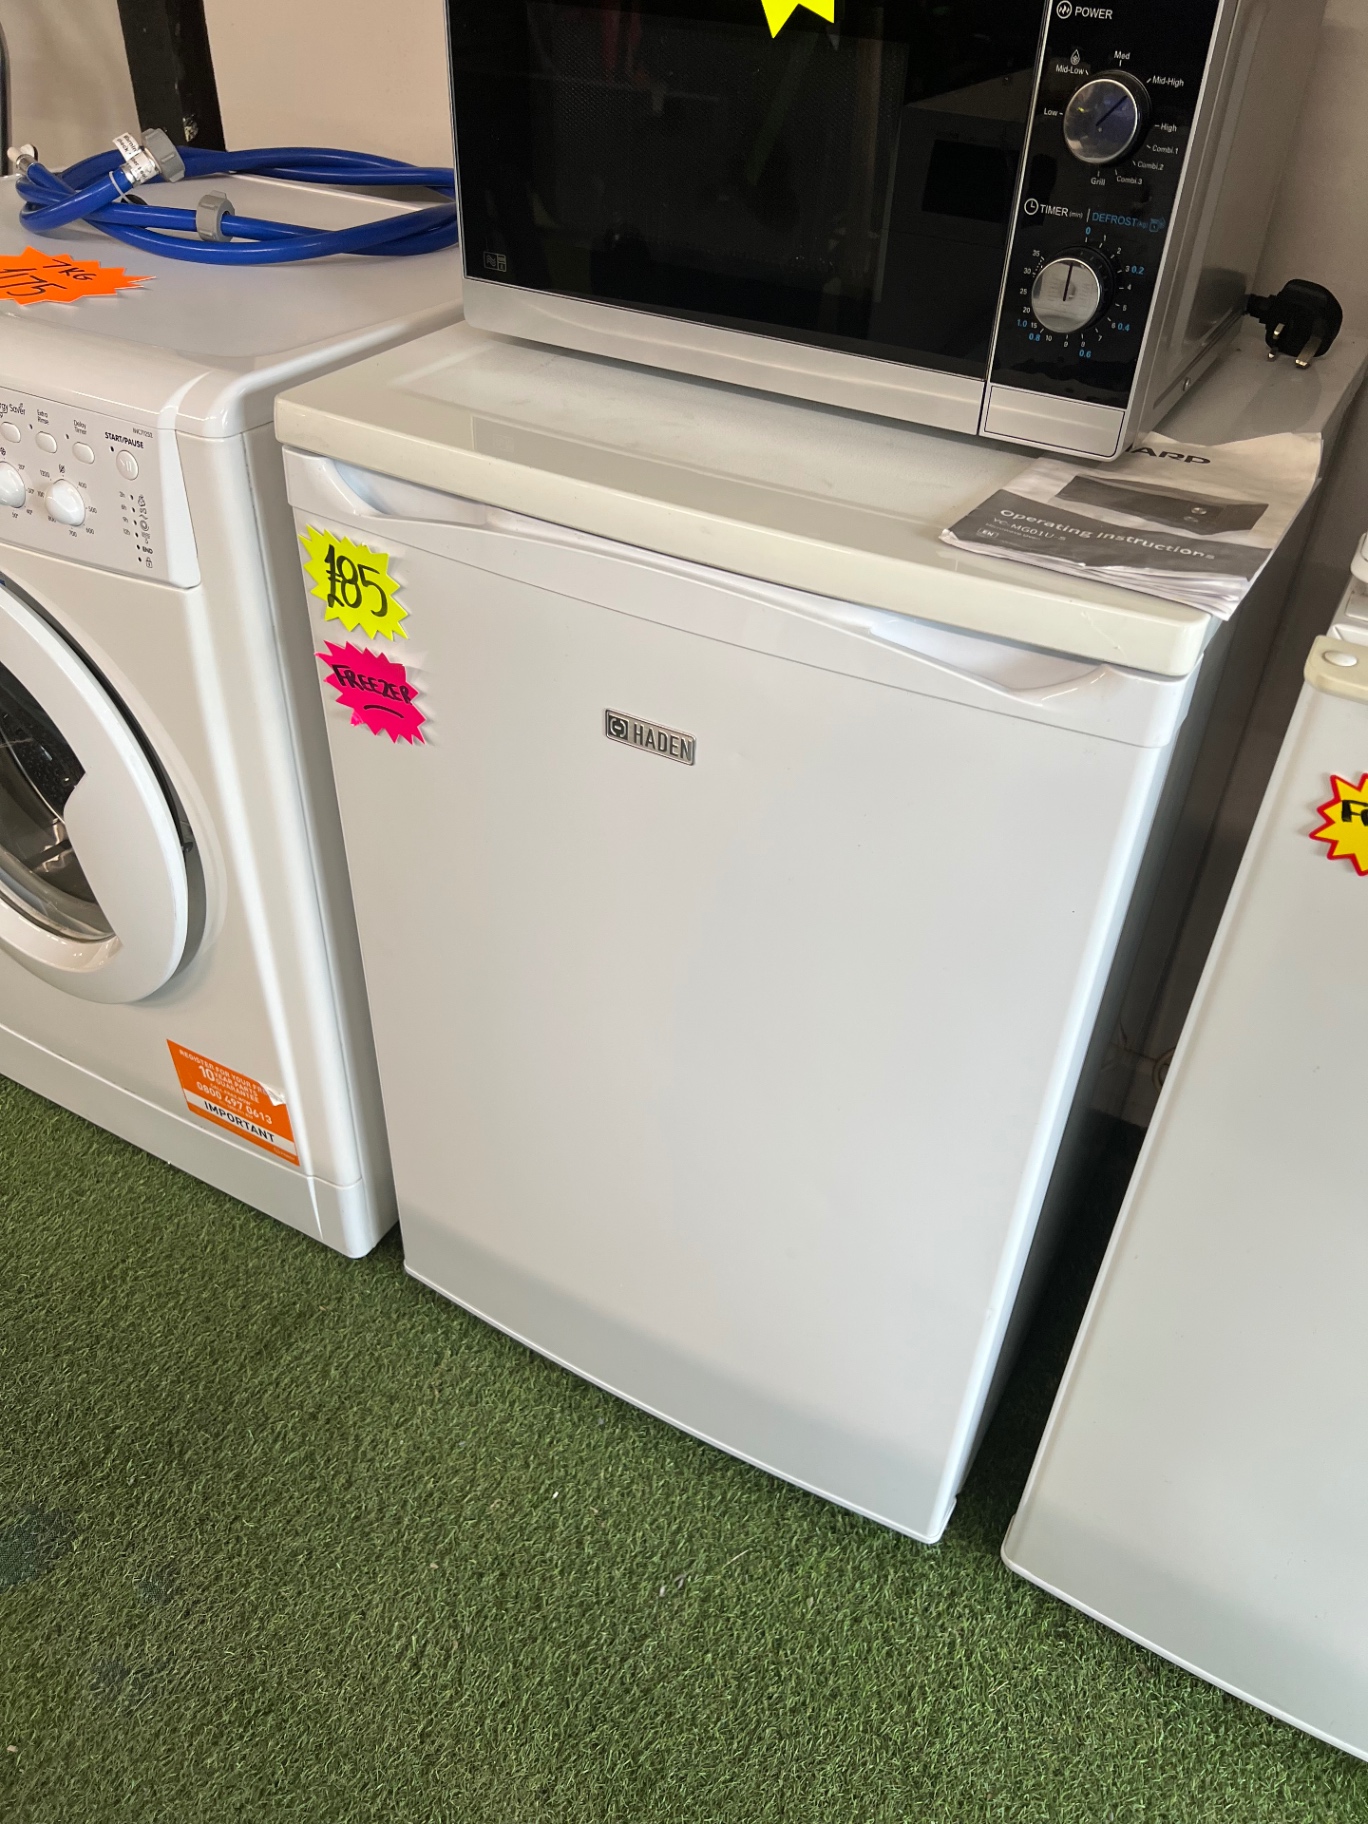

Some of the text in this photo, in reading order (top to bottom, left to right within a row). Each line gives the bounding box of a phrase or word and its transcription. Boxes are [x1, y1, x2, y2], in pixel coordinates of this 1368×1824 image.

[1074, 6, 1113, 20] POWER
[1113, 50, 1131, 60] Med
[1055, 64, 1084, 75] Mid-Low
[1152, 75, 1185, 88] Mid-High
[1043, 107, 1058, 116] Low
[1160, 122, 1177, 133] High
[1090, 176, 1106, 186] Grill
[1040, 204, 1069, 218] TIMER
[1092, 212, 1137, 227] DEFROST
[1085, 226, 1092, 235] 0
[1131, 265, 1145, 275] 0.2
[1022, 306, 1031, 314] 20
[1117, 322, 1131, 332] 0.4
[1078, 349, 1092, 359] 0.6
[104, 431, 145, 449] START/PAUSE
[1124, 444, 1211, 464] ARP
[1000, 509, 1093, 539] Operating
[331, 664, 413, 705] FREEZER
[633, 722, 692, 762] HADEN
[179, 1049, 215, 1070] REGISTER
[215, 1066, 231, 1078] FOR
[198, 1065, 216, 1082] 10
[204, 1100, 275, 1143] IMPORTANT
